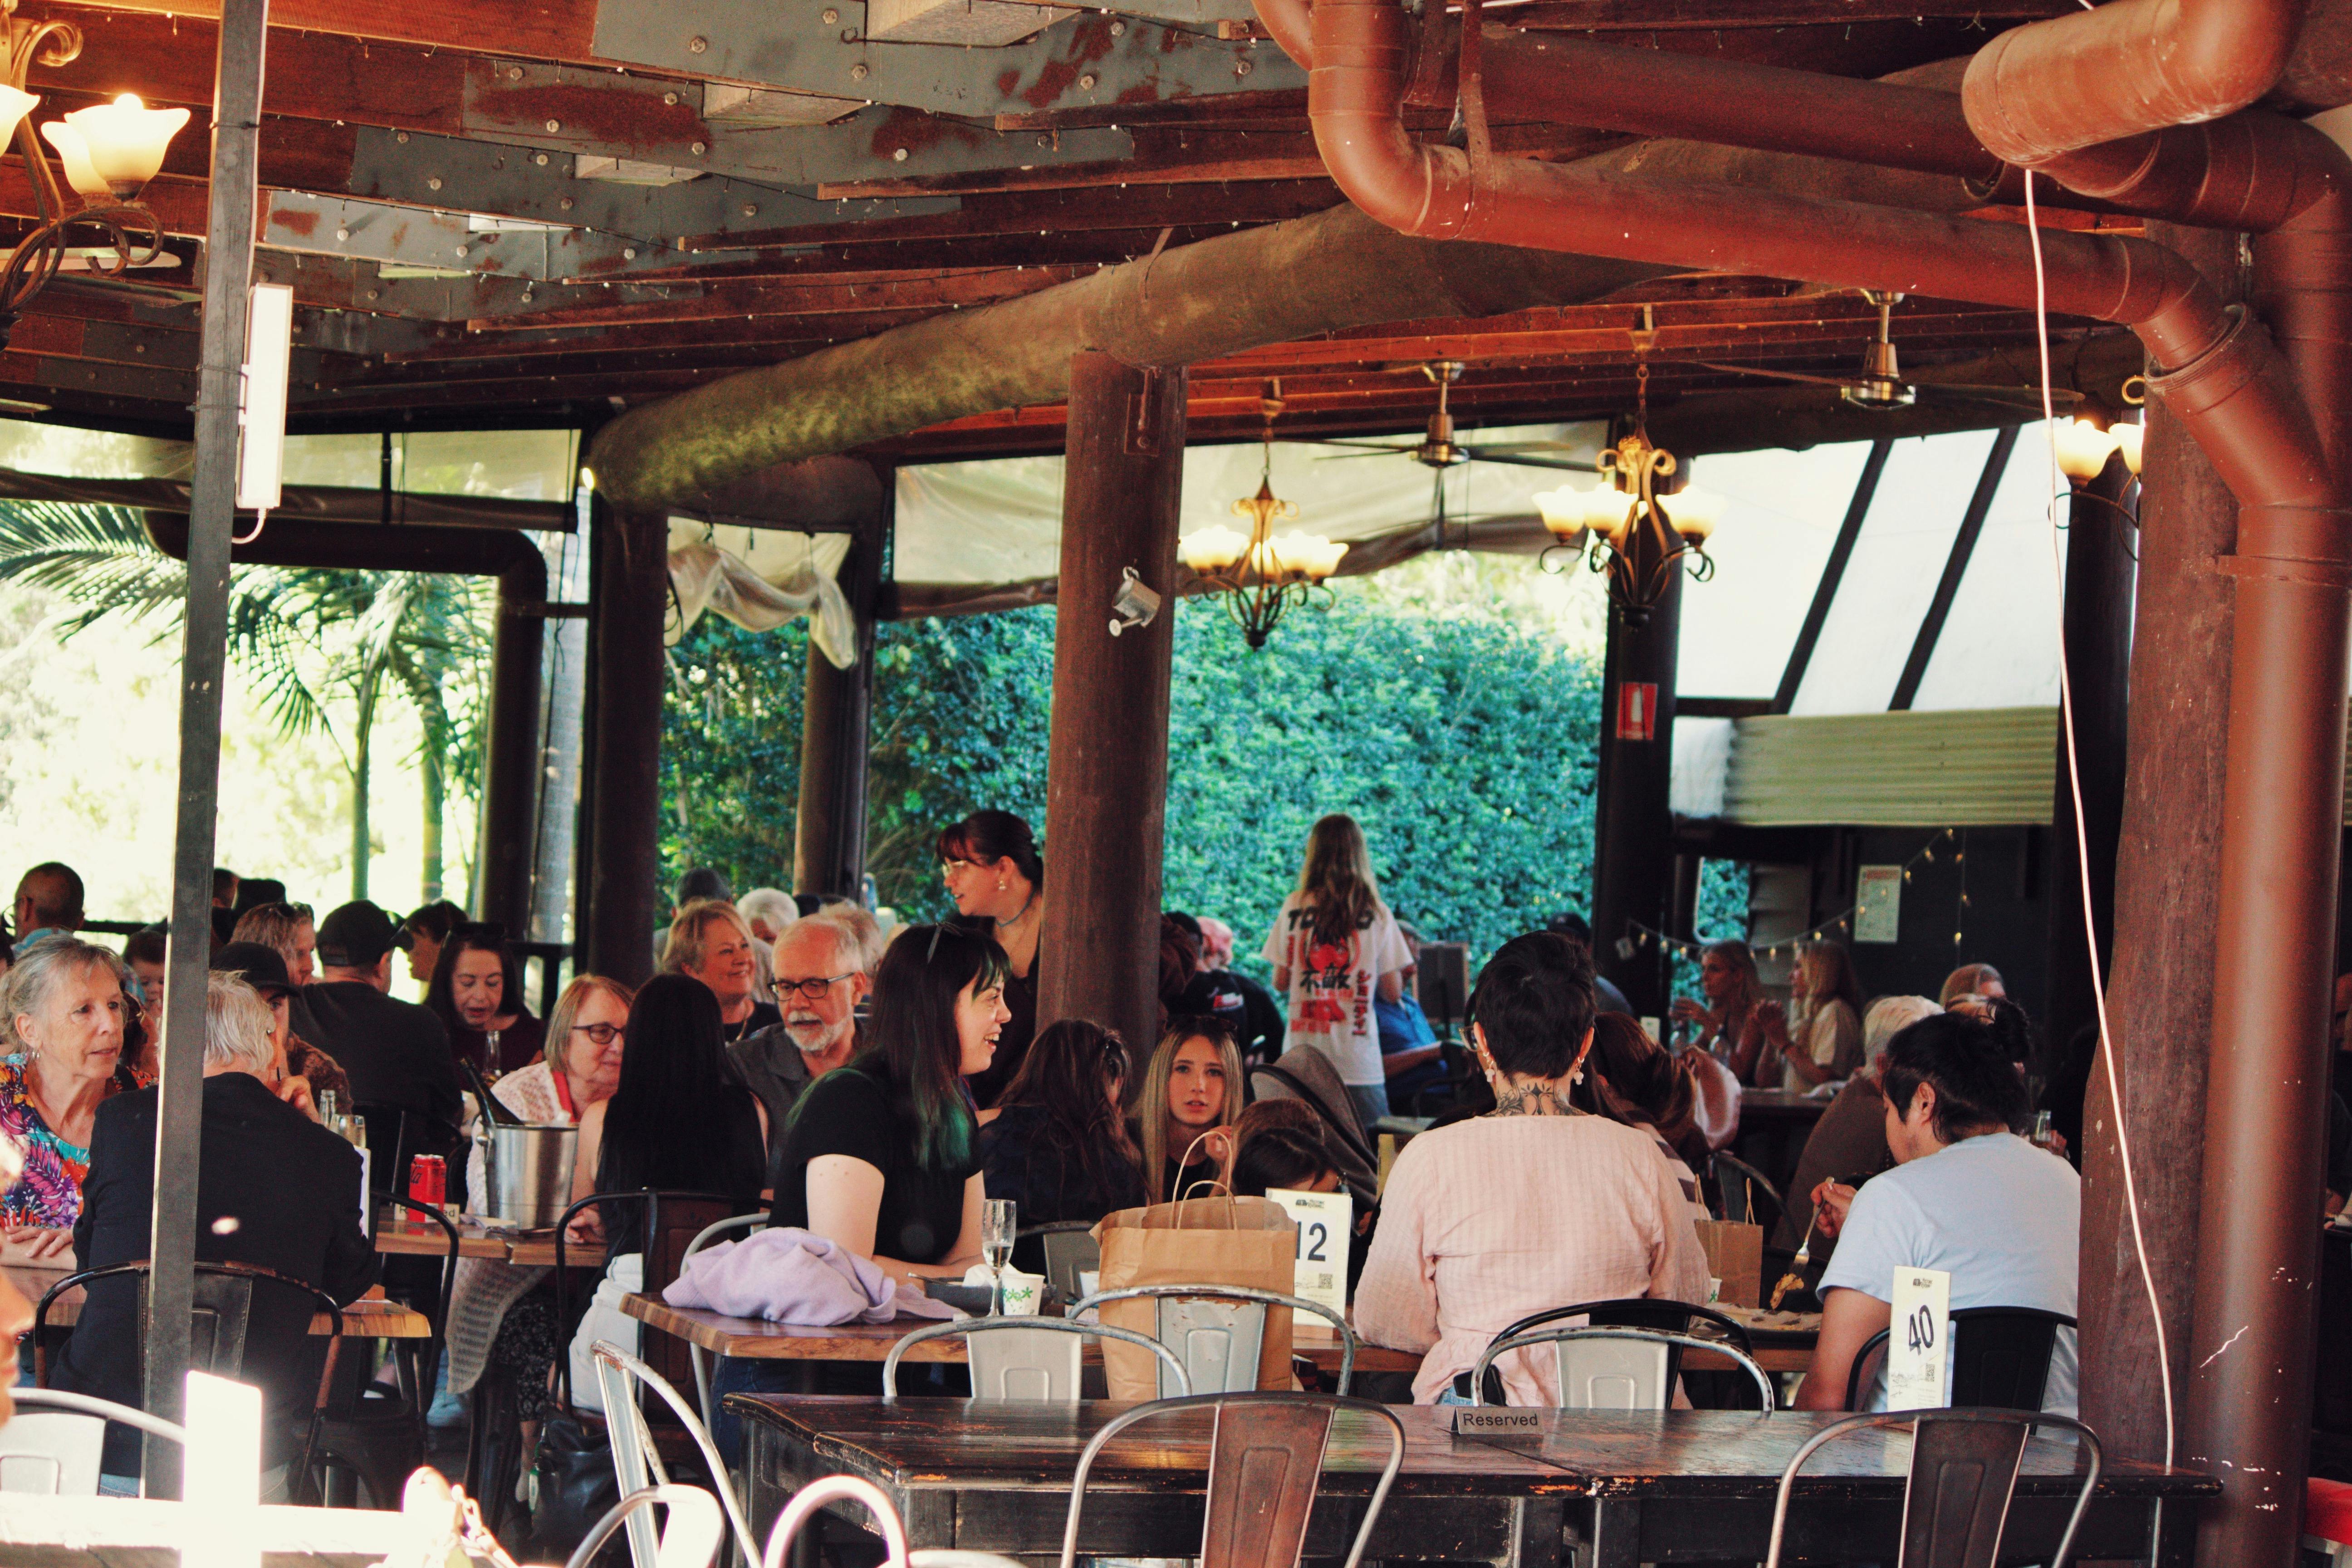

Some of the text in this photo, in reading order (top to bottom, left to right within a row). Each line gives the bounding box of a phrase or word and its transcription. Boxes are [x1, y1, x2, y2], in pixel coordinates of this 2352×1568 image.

[1288, 906, 1374, 931] TOO
[1295, 1221, 1327, 1262] 12
[1909, 1305, 1934, 1356] 40
[1463, 1413, 1538, 1426] Reserved
